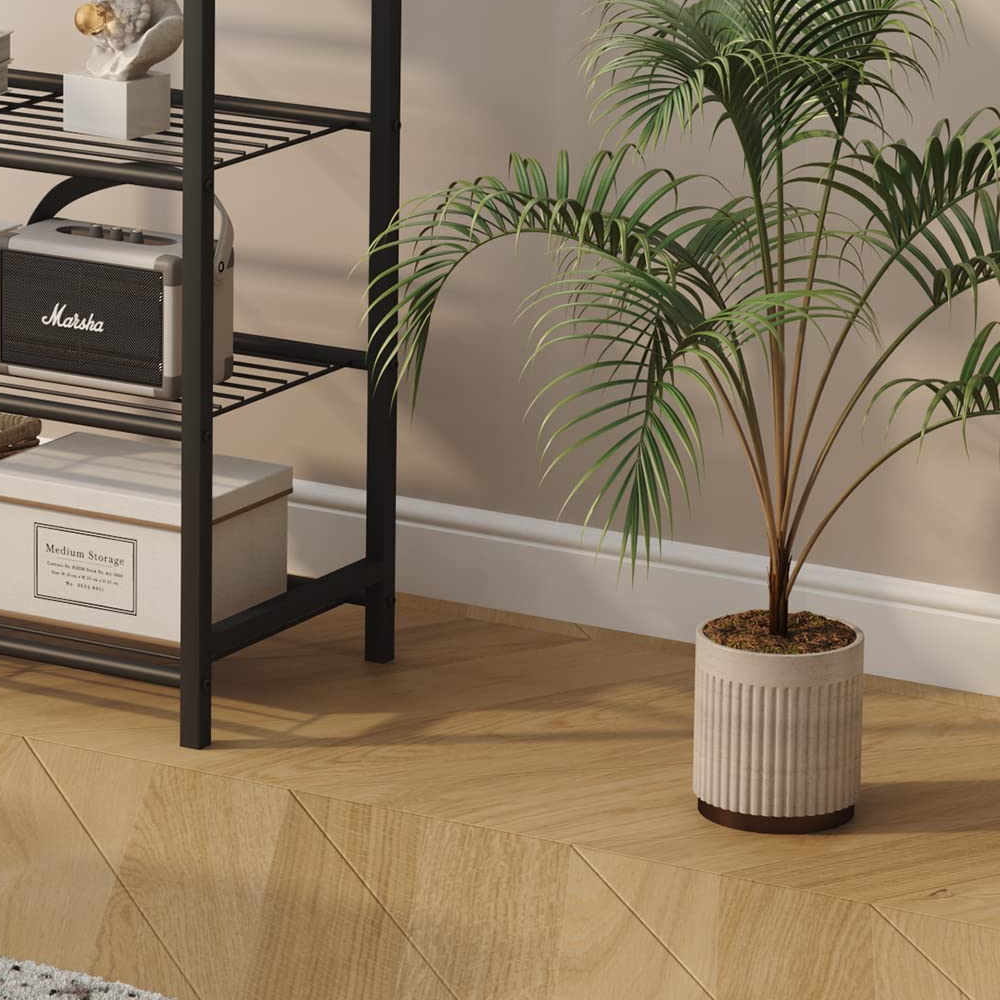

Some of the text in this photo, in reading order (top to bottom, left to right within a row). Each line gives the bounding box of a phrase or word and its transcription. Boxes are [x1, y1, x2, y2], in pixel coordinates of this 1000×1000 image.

[41, 301, 105, 333] Marsha
[45, 543, 125, 567] Medium Storage
